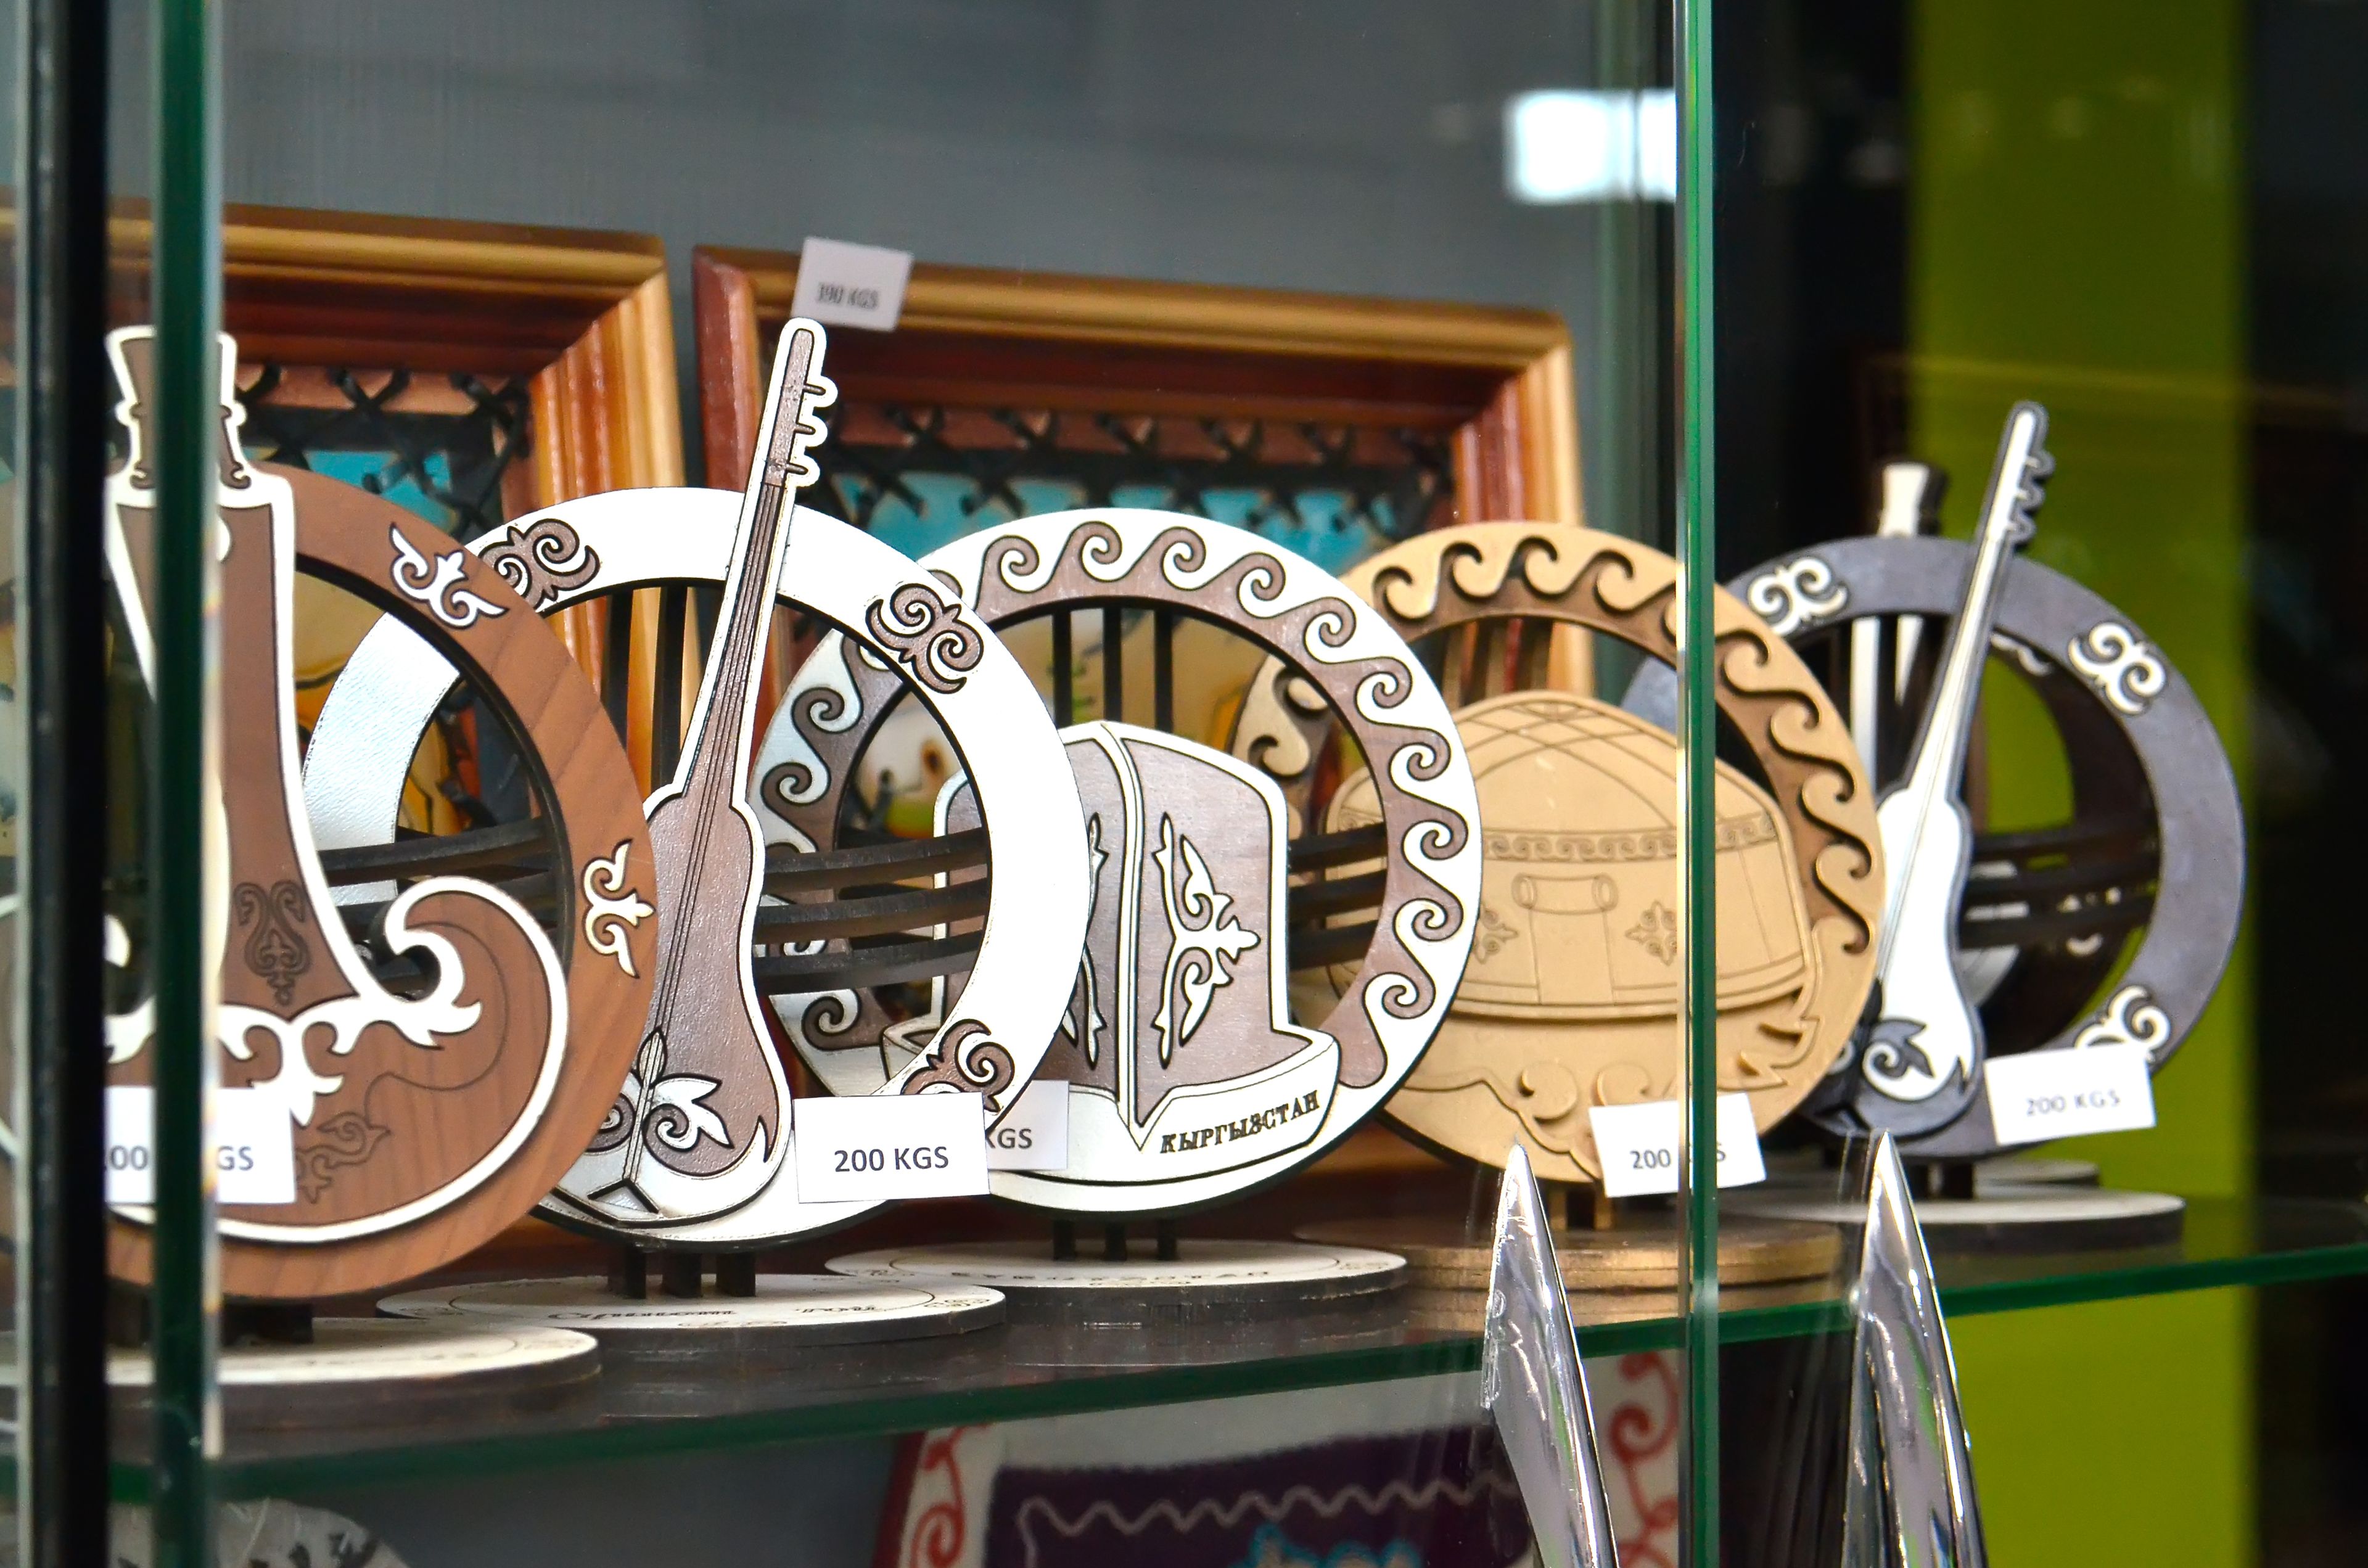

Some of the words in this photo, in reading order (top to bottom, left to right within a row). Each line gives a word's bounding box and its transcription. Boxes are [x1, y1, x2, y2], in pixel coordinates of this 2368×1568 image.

[2026, 1094, 2066, 1117] 200
[2074, 1088, 2120, 1109] KGS
[1160, 1090, 1320, 1154] КЫРГЫЗСТАН
[109, 1145, 148, 1170] 00
[216, 1145, 253, 1170] GS
[834, 1149, 884, 1172] 200
[895, 1146, 949, 1170] KGS
[1629, 1149, 1672, 1169] 200
